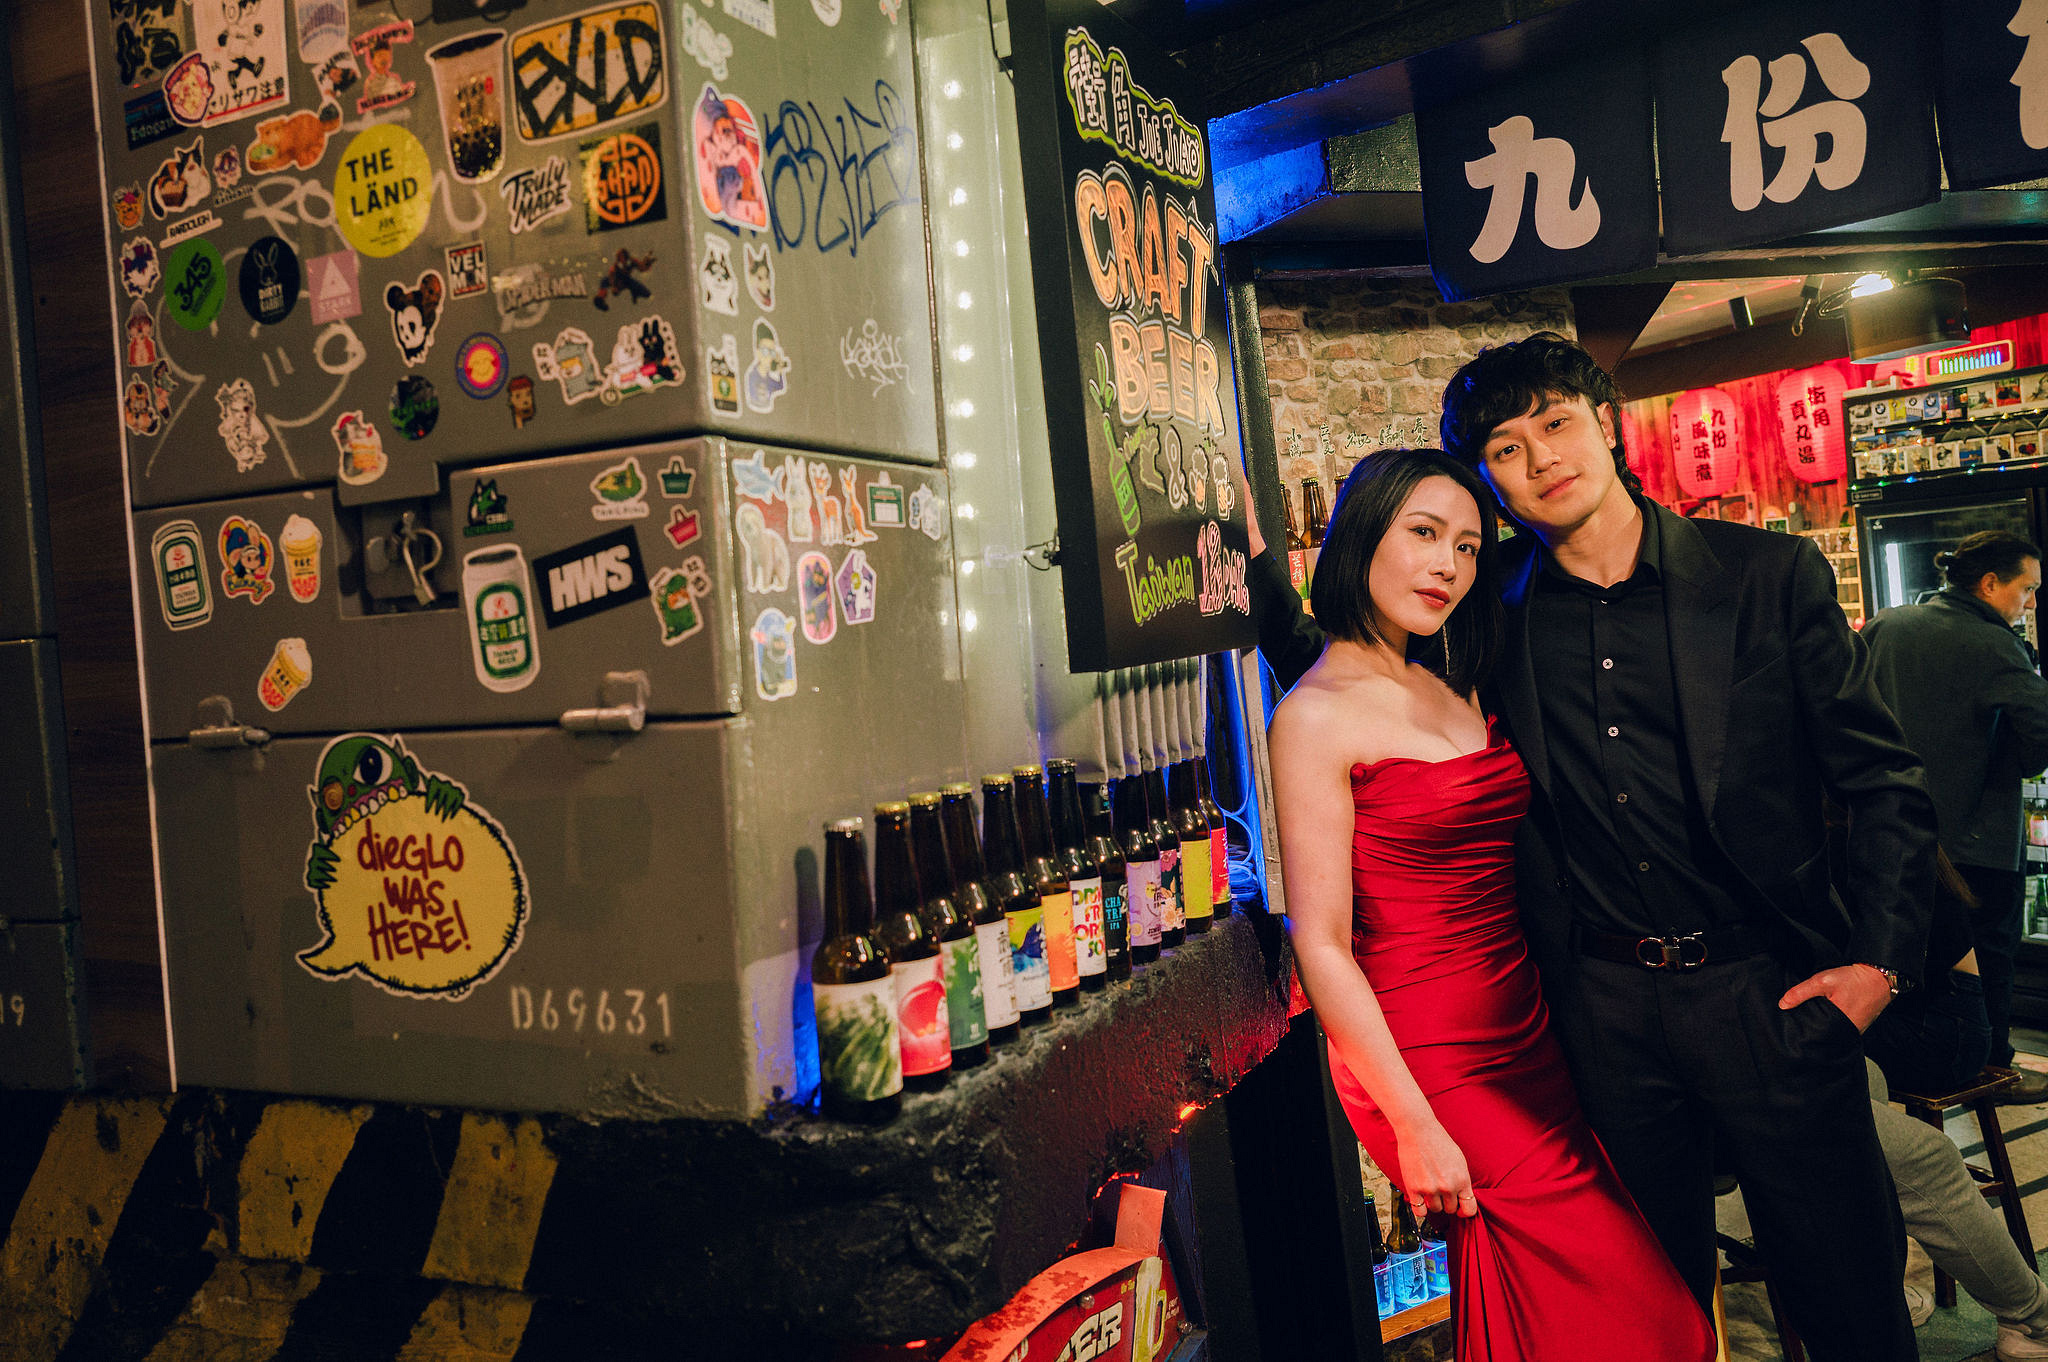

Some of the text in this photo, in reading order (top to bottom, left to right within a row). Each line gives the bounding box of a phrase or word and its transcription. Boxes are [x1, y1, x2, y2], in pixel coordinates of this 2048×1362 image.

[1068, 44, 1136, 152] 街角
[346, 147, 394, 182] THE
[503, 159, 566, 210] TRULY
[350, 177, 418, 218] LÄND
[514, 184, 567, 228] MADE
[450, 251, 484, 275] VEL
[1075, 168, 1214, 338] CRAFT
[173, 251, 212, 311] 345
[1109, 311, 1225, 437] BEER
[1711, 408, 1727, 449] 九份
[548, 544, 634, 613] HWS
[1115, 538, 1197, 627] Taiwan
[382, 874, 446, 921] WAS
[367, 900, 473, 961] HERE!
[510, 985, 672, 1038] D69631
